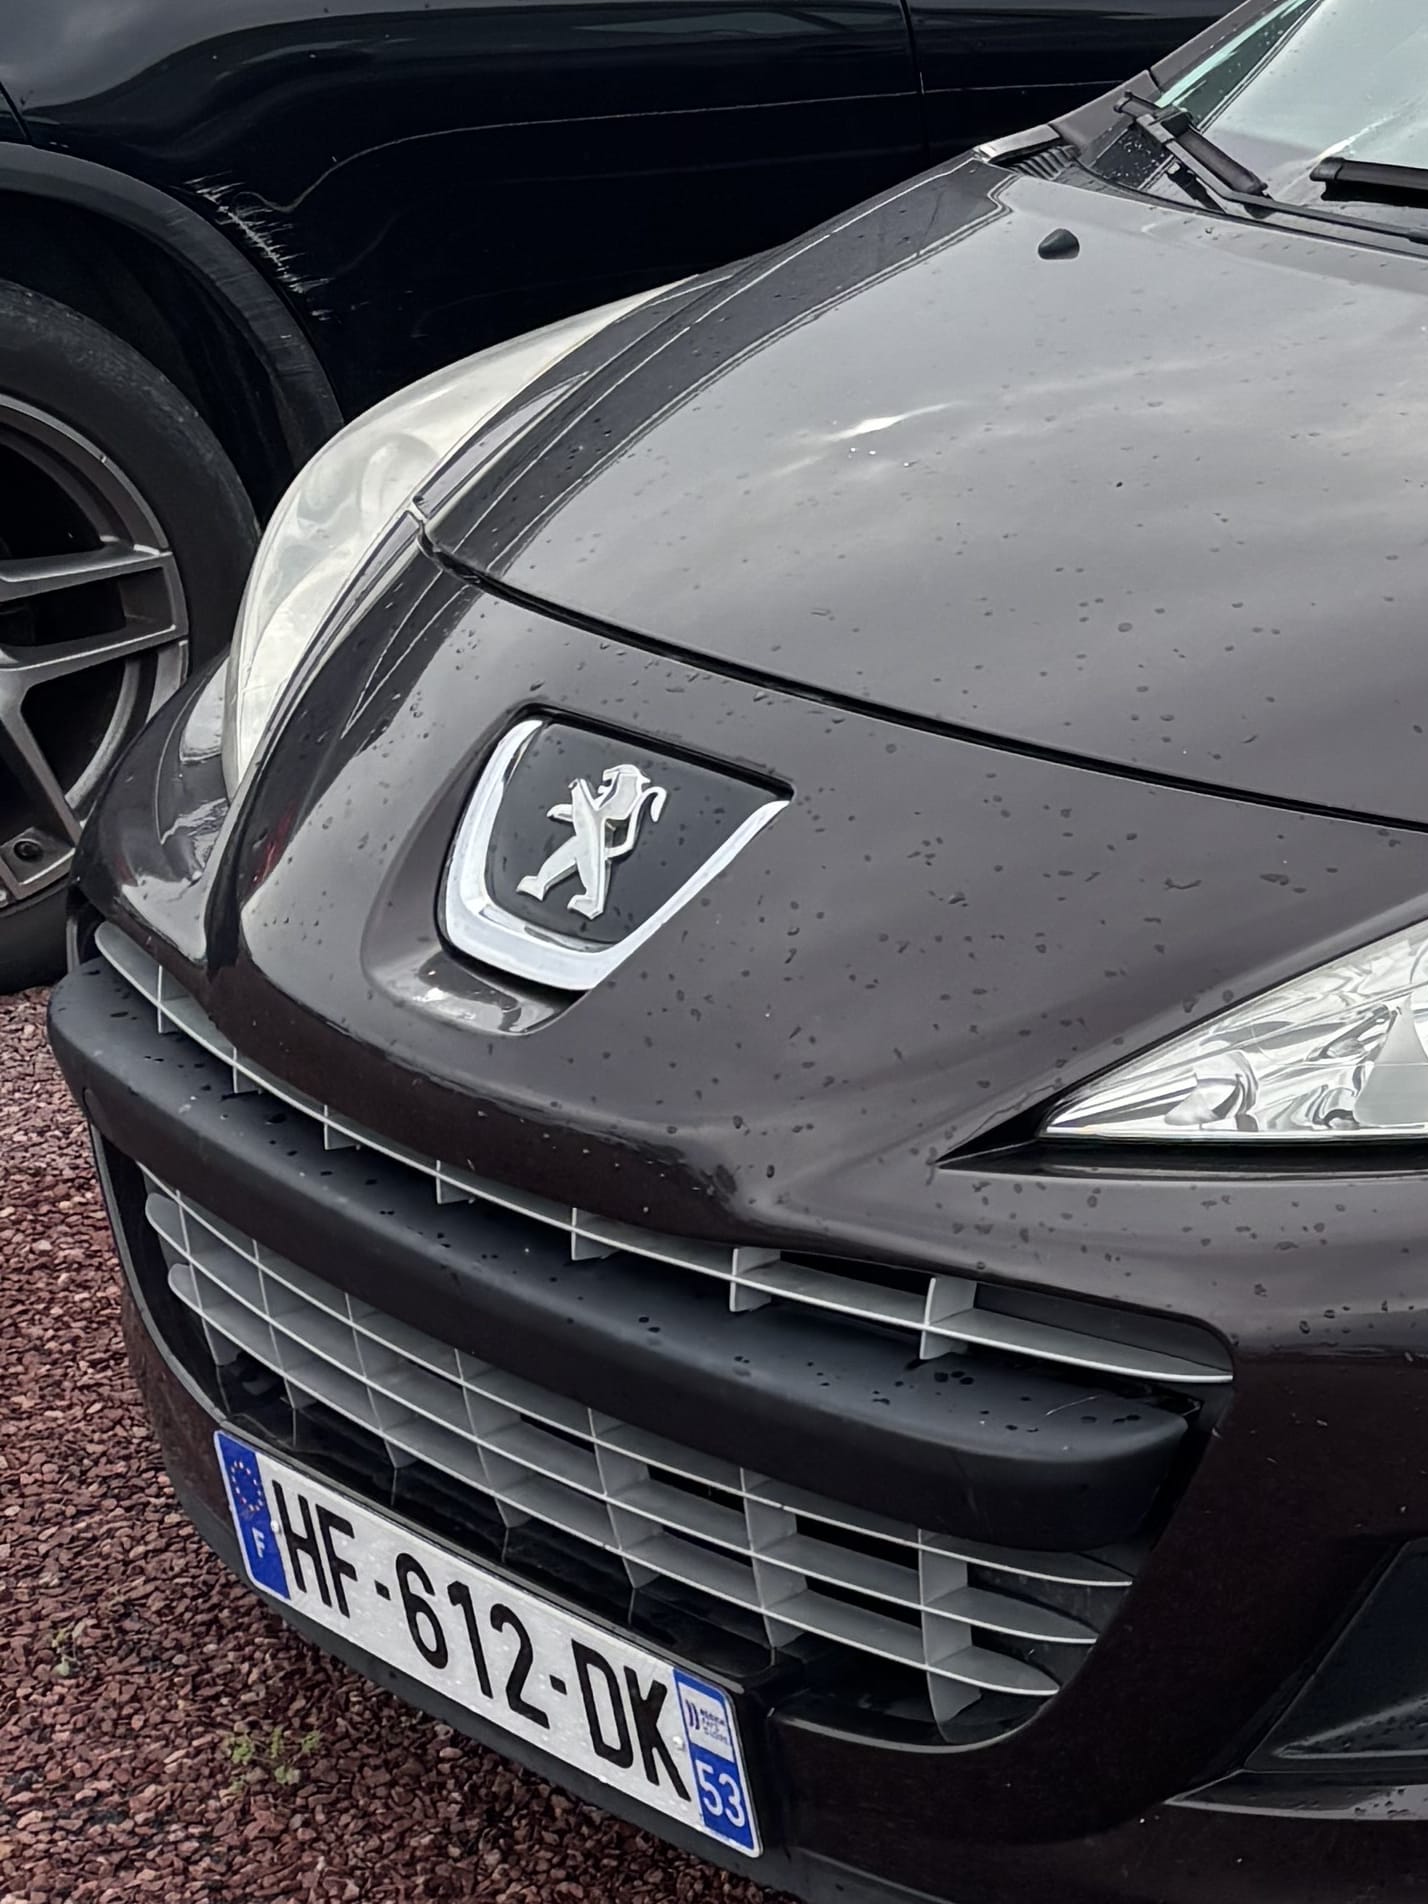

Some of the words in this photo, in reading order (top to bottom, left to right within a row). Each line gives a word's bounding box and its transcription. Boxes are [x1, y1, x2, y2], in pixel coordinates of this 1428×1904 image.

[251, 1529, 266, 1558] F
[271, 1480, 691, 1801] HF-612-DK
[697, 1760, 746, 1828] 53
